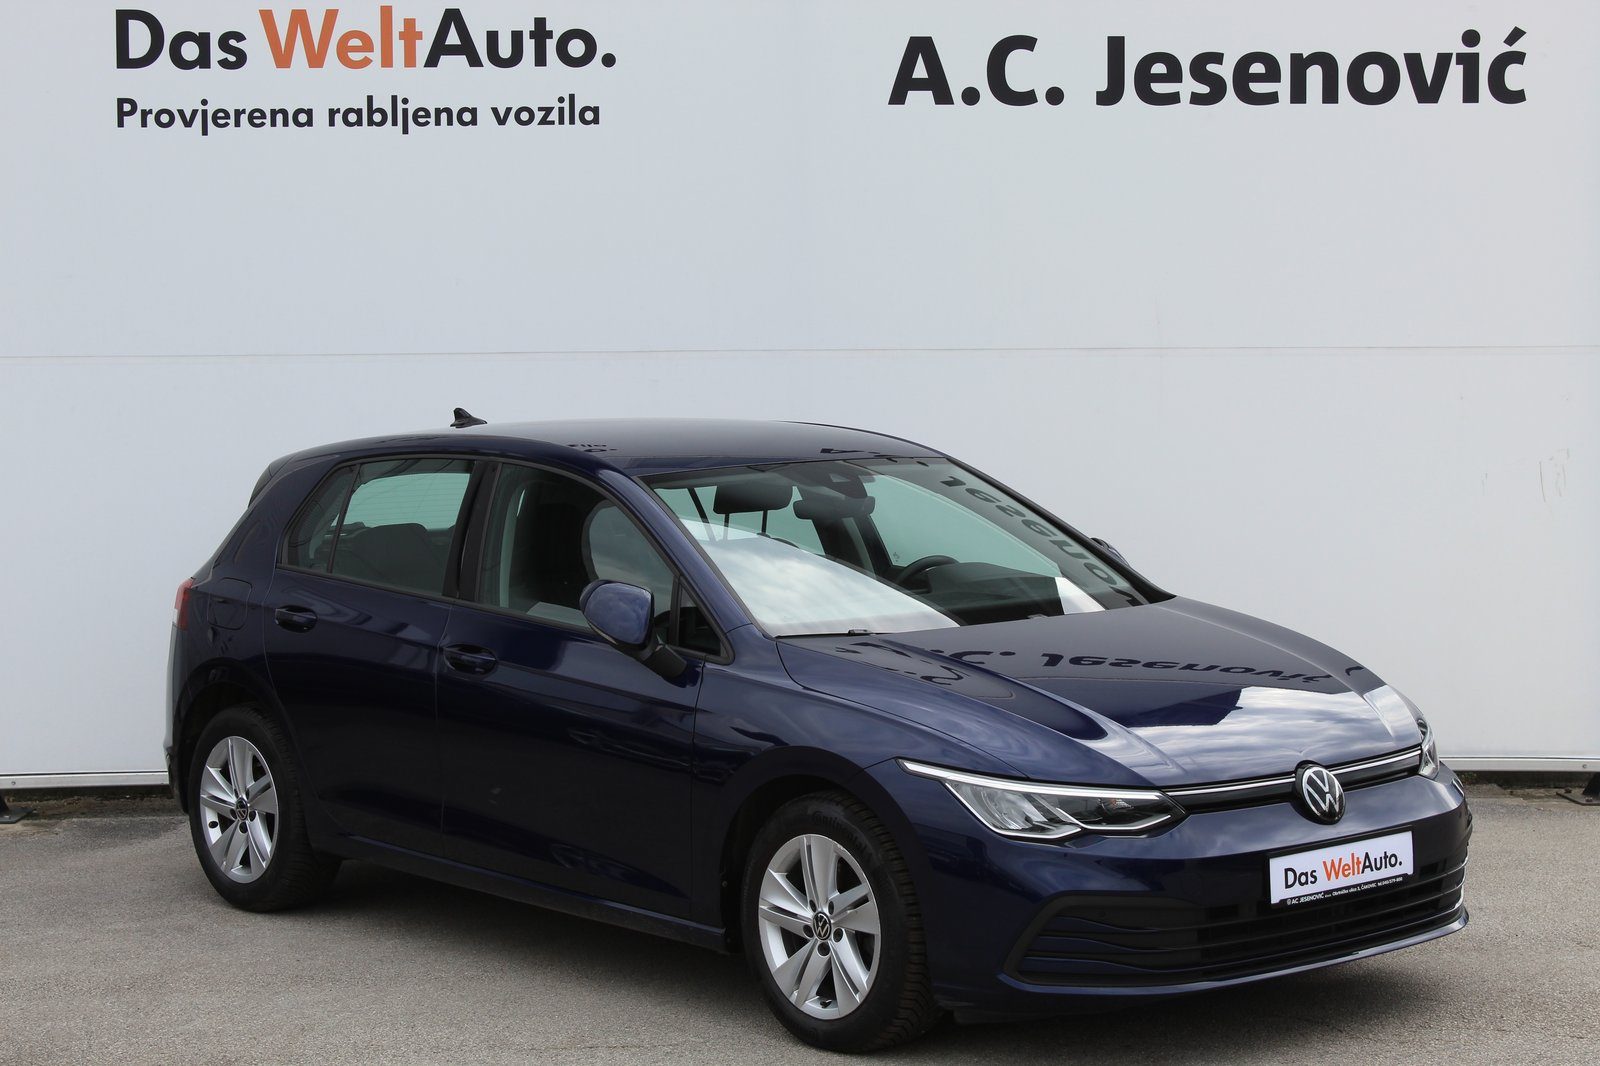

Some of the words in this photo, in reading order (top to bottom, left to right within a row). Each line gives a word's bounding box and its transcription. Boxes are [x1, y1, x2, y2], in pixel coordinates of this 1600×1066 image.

[116, 9, 247, 70] Das
[259, 6, 616, 69] WeltAuto.
[888, 35, 1064, 106] A.C.
[1096, 26, 1526, 106] Jesenović
[117, 98, 313, 136] Provjerena
[329, 95, 477, 134] rabljena
[491, 94, 599, 126] vozila
[1284, 867, 1318, 890] Das
[1322, 851, 1403, 882] WeltAuto.
